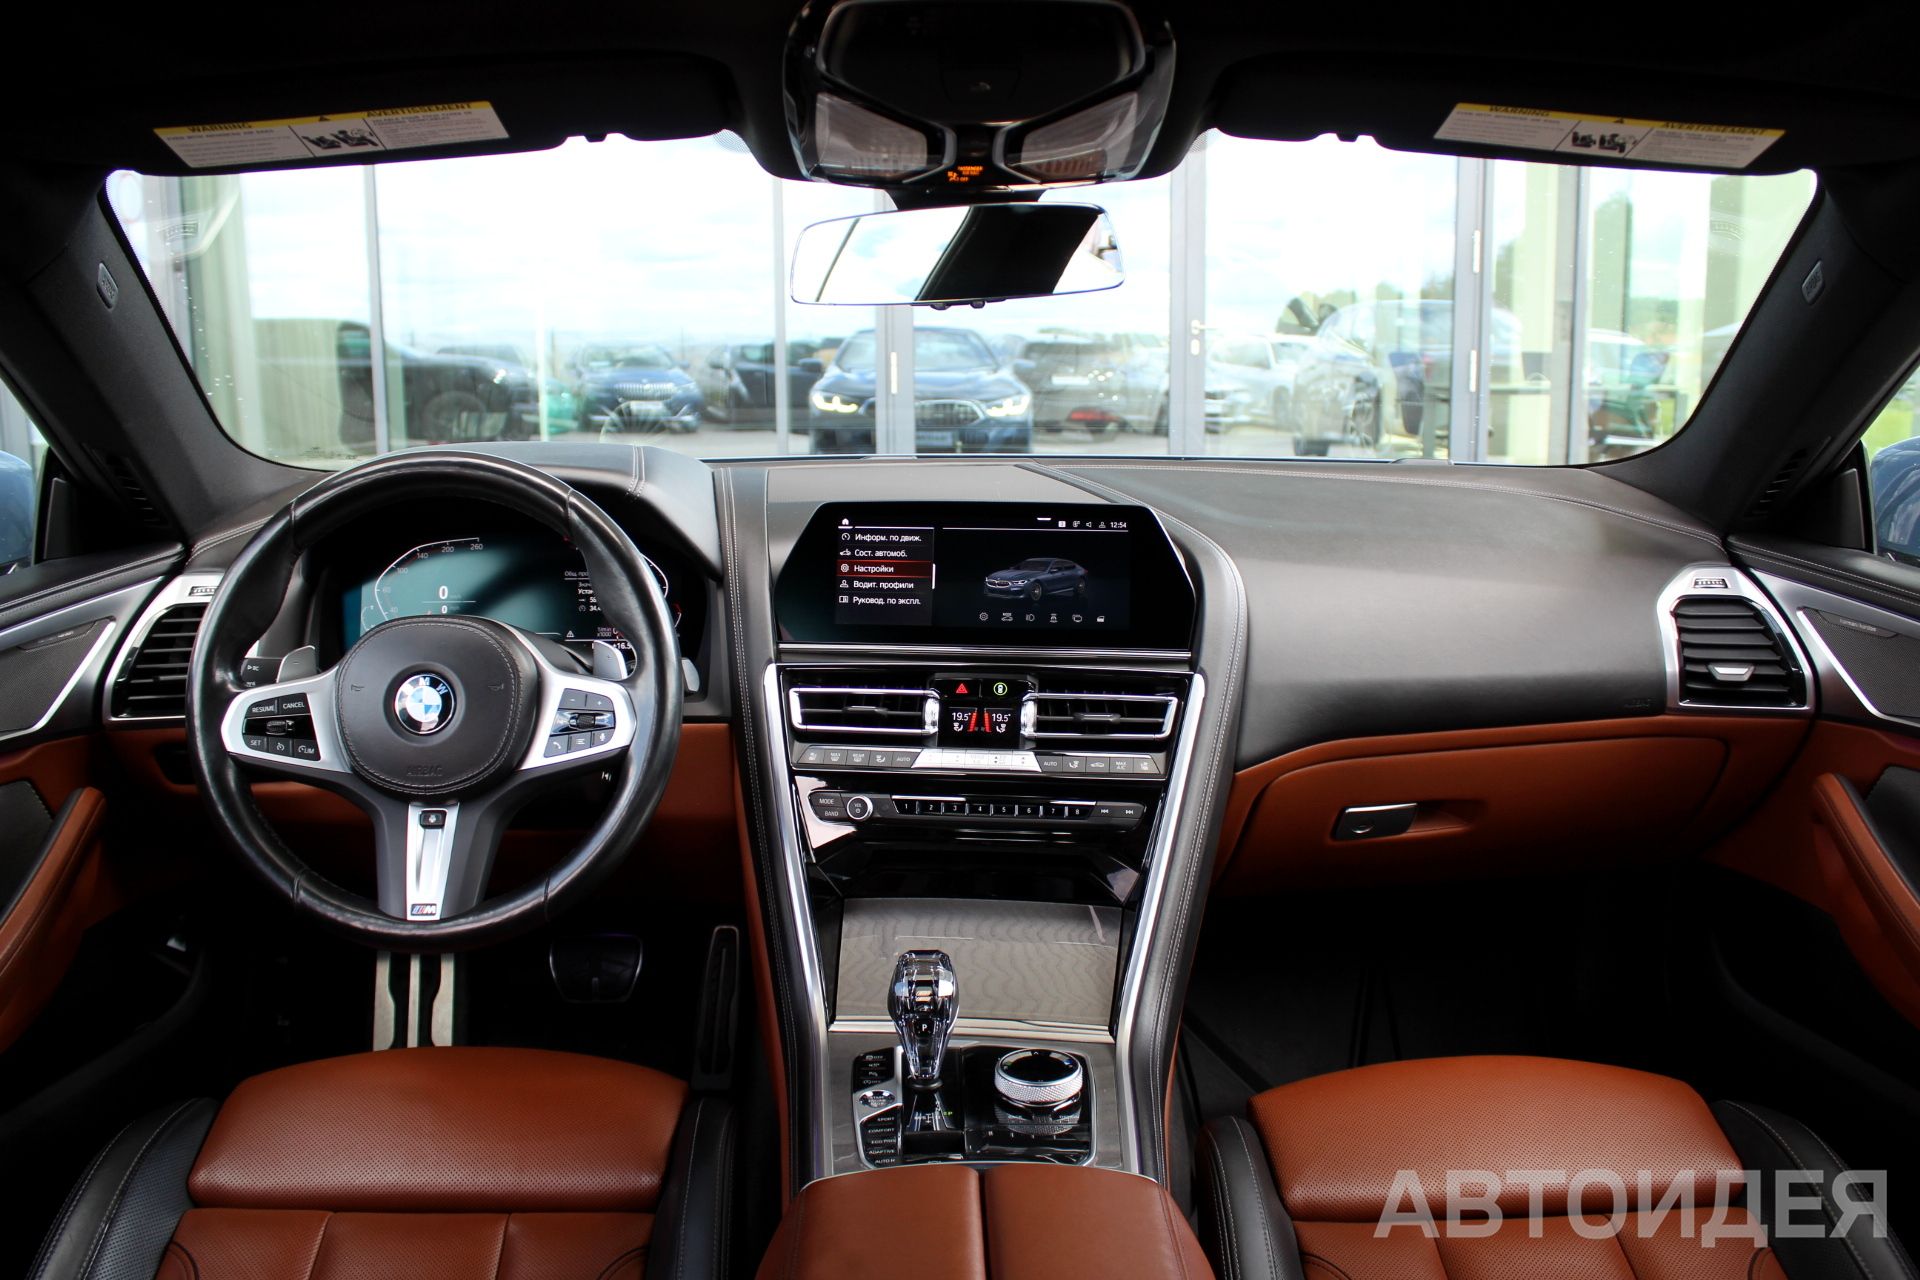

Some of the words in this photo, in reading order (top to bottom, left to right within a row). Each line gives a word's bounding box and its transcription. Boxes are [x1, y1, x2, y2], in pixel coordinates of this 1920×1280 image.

[367, 102, 472, 117] AVERTISSEMENT
[1489, 105, 1550, 117] WARNING
[187, 121, 252, 133] WARNING
[1664, 122, 1766, 136] AVERTISSEMENT
[1110, 521, 1127, 529] 12:54
[855, 533, 888, 542] Информ.
[854, 549, 874, 557] Сост.
[875, 549, 908, 557] автомоб.
[854, 564, 894, 574] Настройки
[853, 580, 878, 589] Водит.
[879, 581, 914, 590] профили
[439, 585, 448, 599] 0
[852, 596, 885, 605] Руковод.
[441, 605, 448, 614] 0
[252, 705, 275, 713] RESUME
[283, 701, 305, 709] CANCEL
